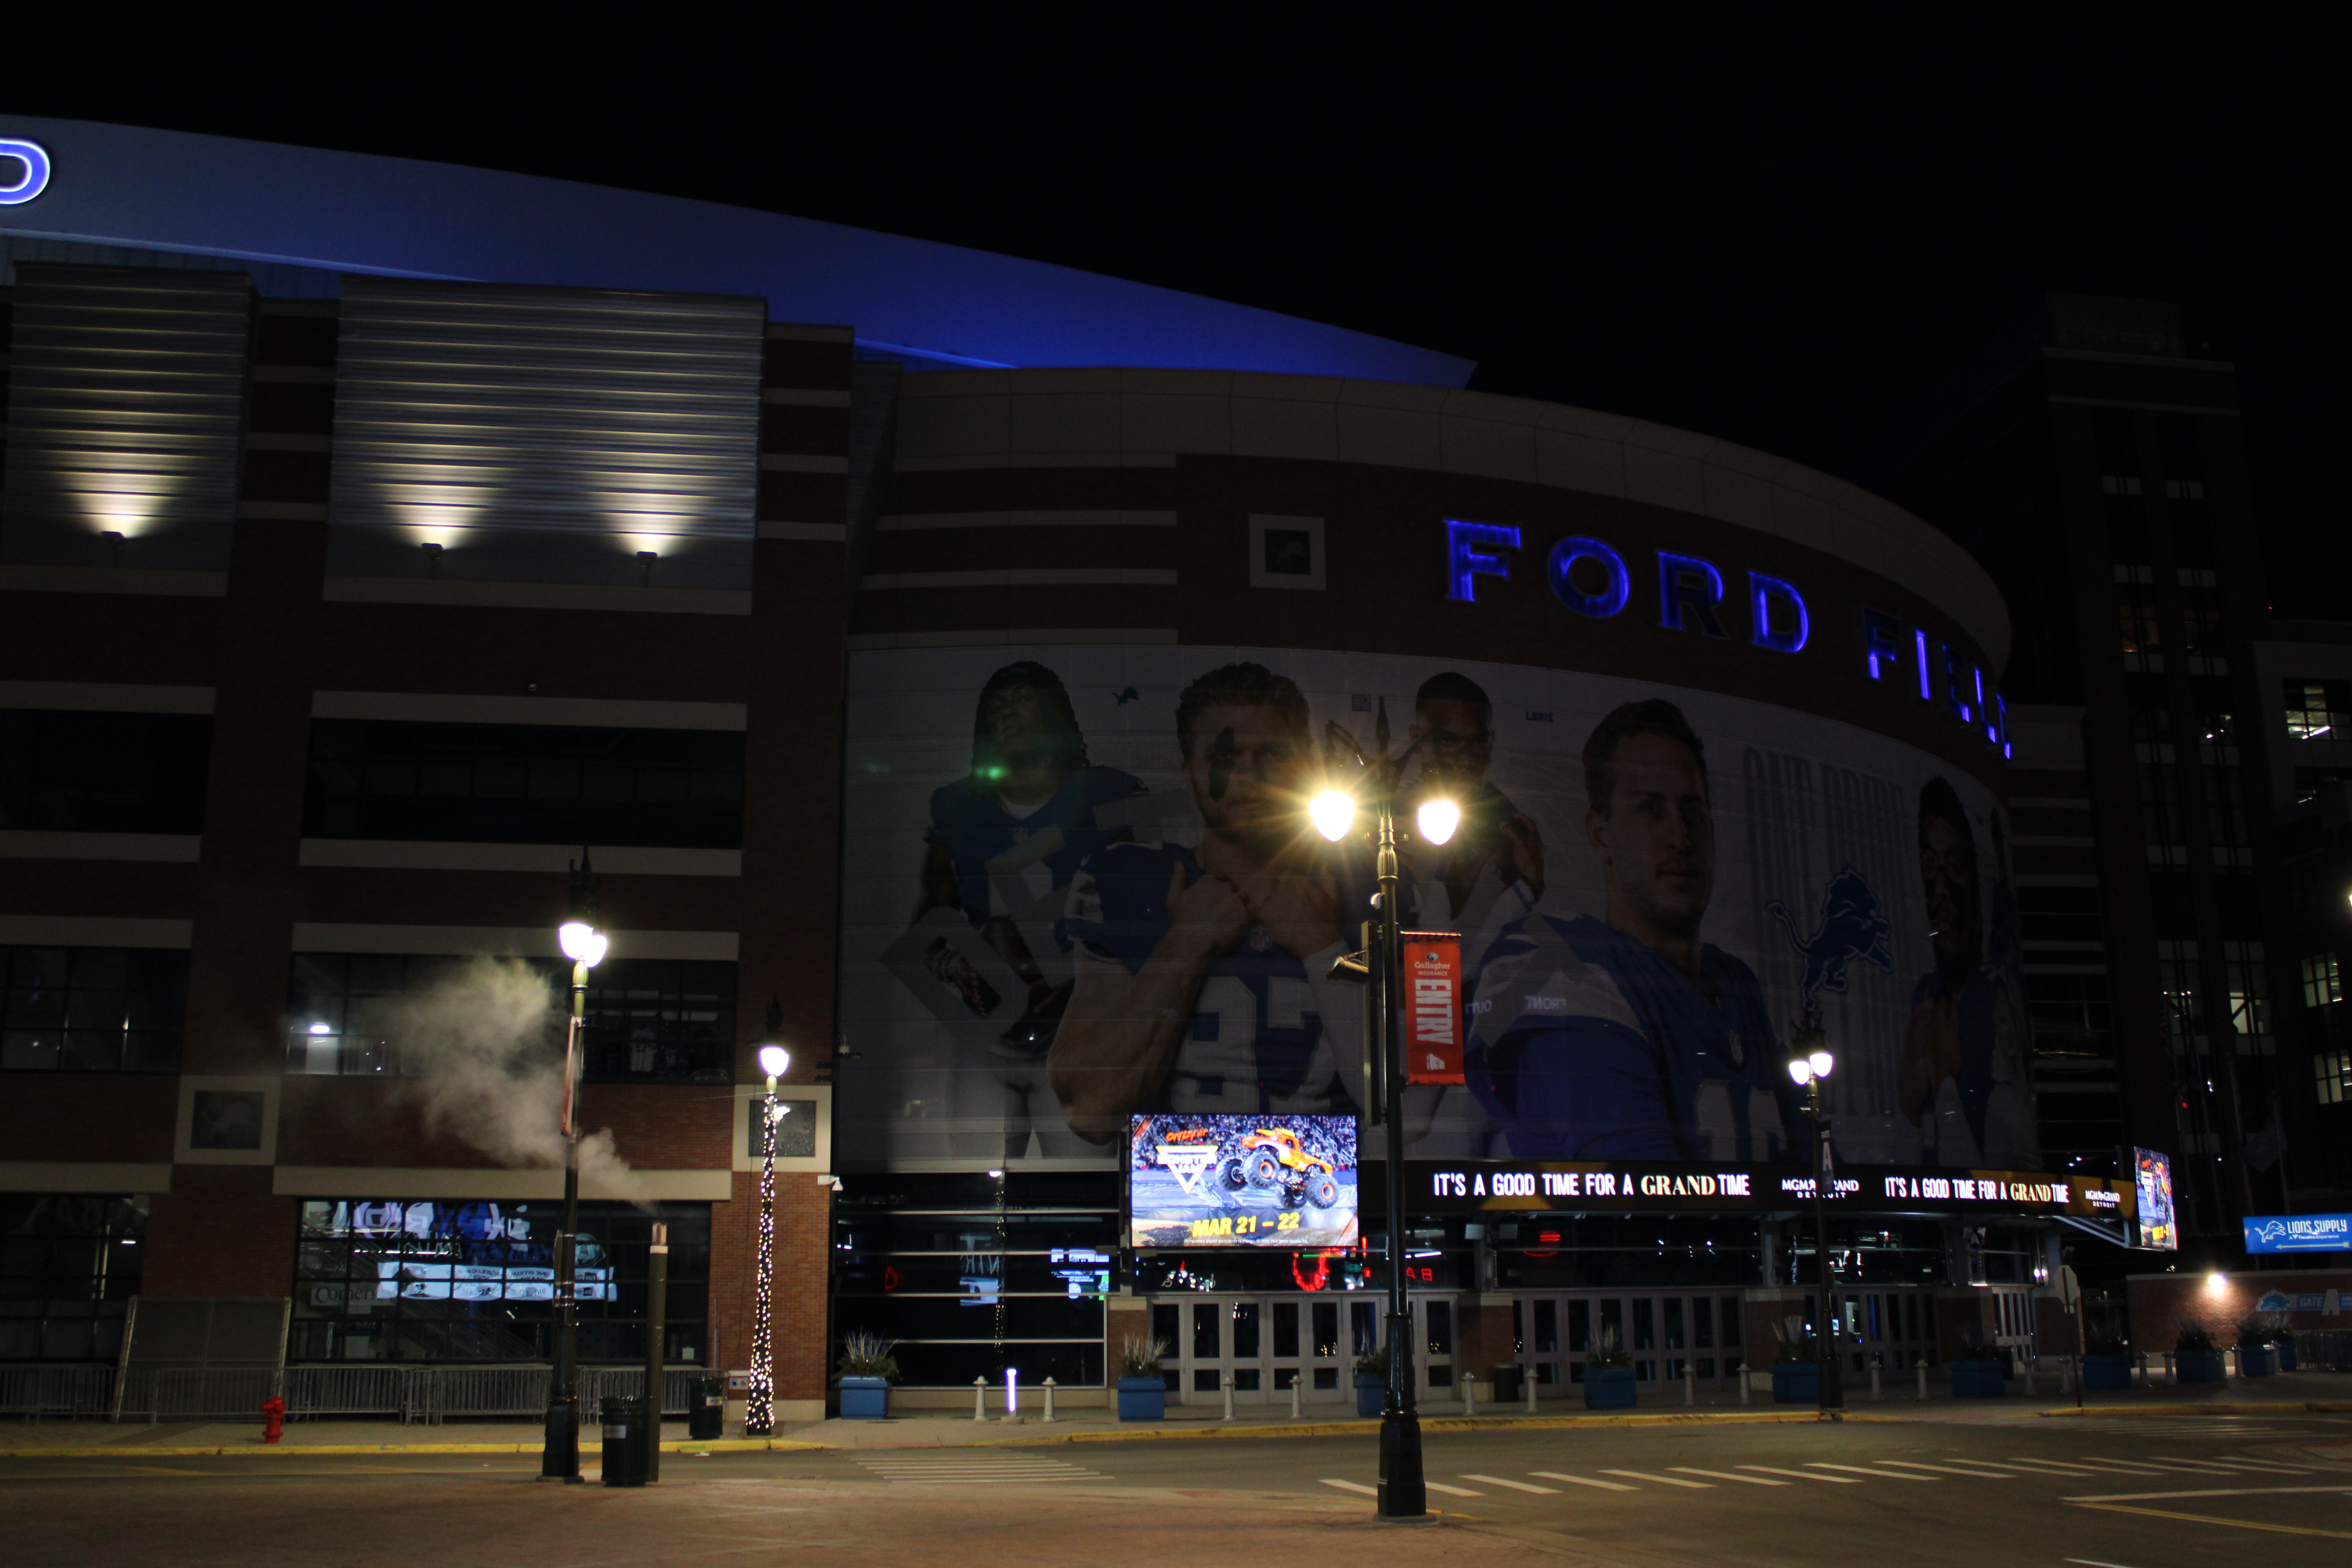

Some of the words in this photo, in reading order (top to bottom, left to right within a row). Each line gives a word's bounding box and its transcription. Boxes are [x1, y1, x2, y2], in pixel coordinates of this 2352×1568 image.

[1443, 519, 1809, 653] FORD
[1862, 602, 2012, 760] FIELD
[1415, 962, 1450, 971] Gallagher
[1415, 979, 1454, 1045] ENTRY
[1165, 1130, 1196, 1142] ONLY
[1197, 1129, 1209, 1137] AT
[1157, 1154, 1217, 1165] MONSTER
[1174, 1164, 1202, 1174] JAM
[1434, 1173, 1466, 1196] IT'S
[1474, 1173, 1486, 1196] A
[1493, 1173, 1535, 1196] GOOD
[1542, 1173, 1579, 1195] TIME
[1585, 1173, 1616, 1195] FOR
[1623, 1174, 1634, 1195] A
[1641, 1175, 1716, 1195] GRAND
[1717, 1174, 1750, 1195] TIME
[1782, 1178, 1809, 1191] MGM
[1885, 1177, 1907, 1197] IT'S
[1911, 1178, 1920, 1198] A
[1922, 1178, 1949, 1198] GOOD
[1952, 1179, 1976, 1199] TIME
[1978, 1180, 1998, 1200] FOR
[2000, 1181, 2007, 1200] A
[2010, 1183, 2052, 1202] GRAND
[2051, 1184, 2070, 1203] TIME
[2085, 1189, 2100, 1200] MGM
[2103, 1191, 2121, 1203] GRAND
[1192, 1217, 1232, 1238] MAR
[1236, 1215, 1257, 1234] 21
[1277, 1212, 1300, 1230] 22
[2287, 1220, 2312, 1234] LIONS
[2314, 1219, 2348, 1232] SUPPLY
[2300, 1297, 2322, 1307] GATE
[2321, 1289, 2340, 1316] A
